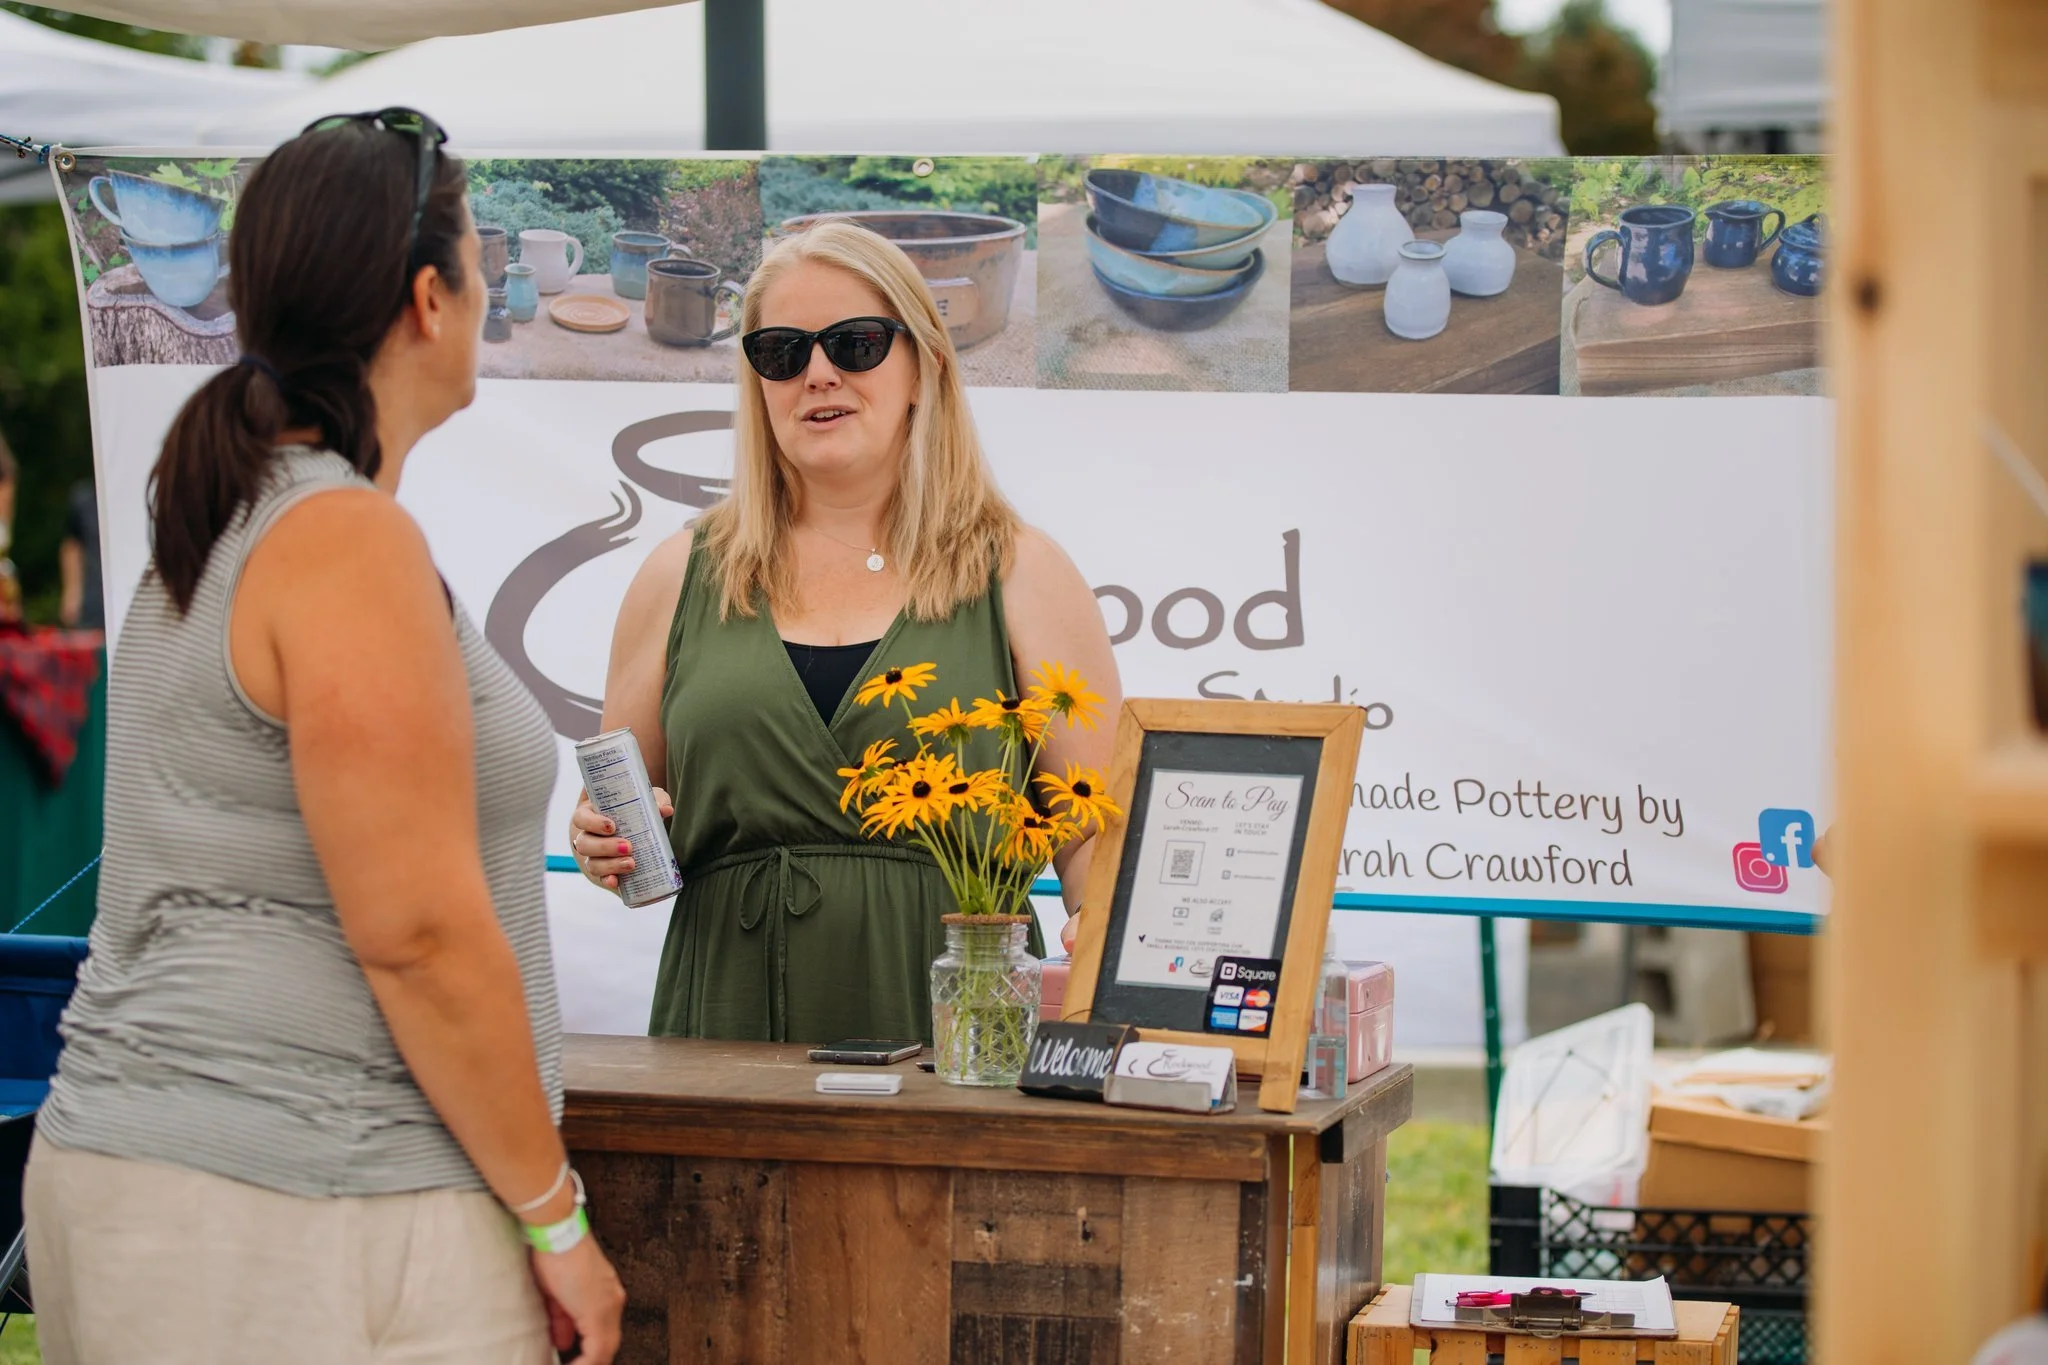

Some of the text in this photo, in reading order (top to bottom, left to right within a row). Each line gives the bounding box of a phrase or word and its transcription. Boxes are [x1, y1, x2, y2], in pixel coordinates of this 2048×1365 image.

[1165, 781, 1290, 822] Scan to Pay
[1453, 778, 1623, 835] Pottery
[1637, 784, 1685, 838] by
[1426, 842, 1634, 888] Crawford
[1237, 965, 1277, 982] Square
[1220, 991, 1240, 1001] VISA
[1029, 1037, 1113, 1080] Welcome
